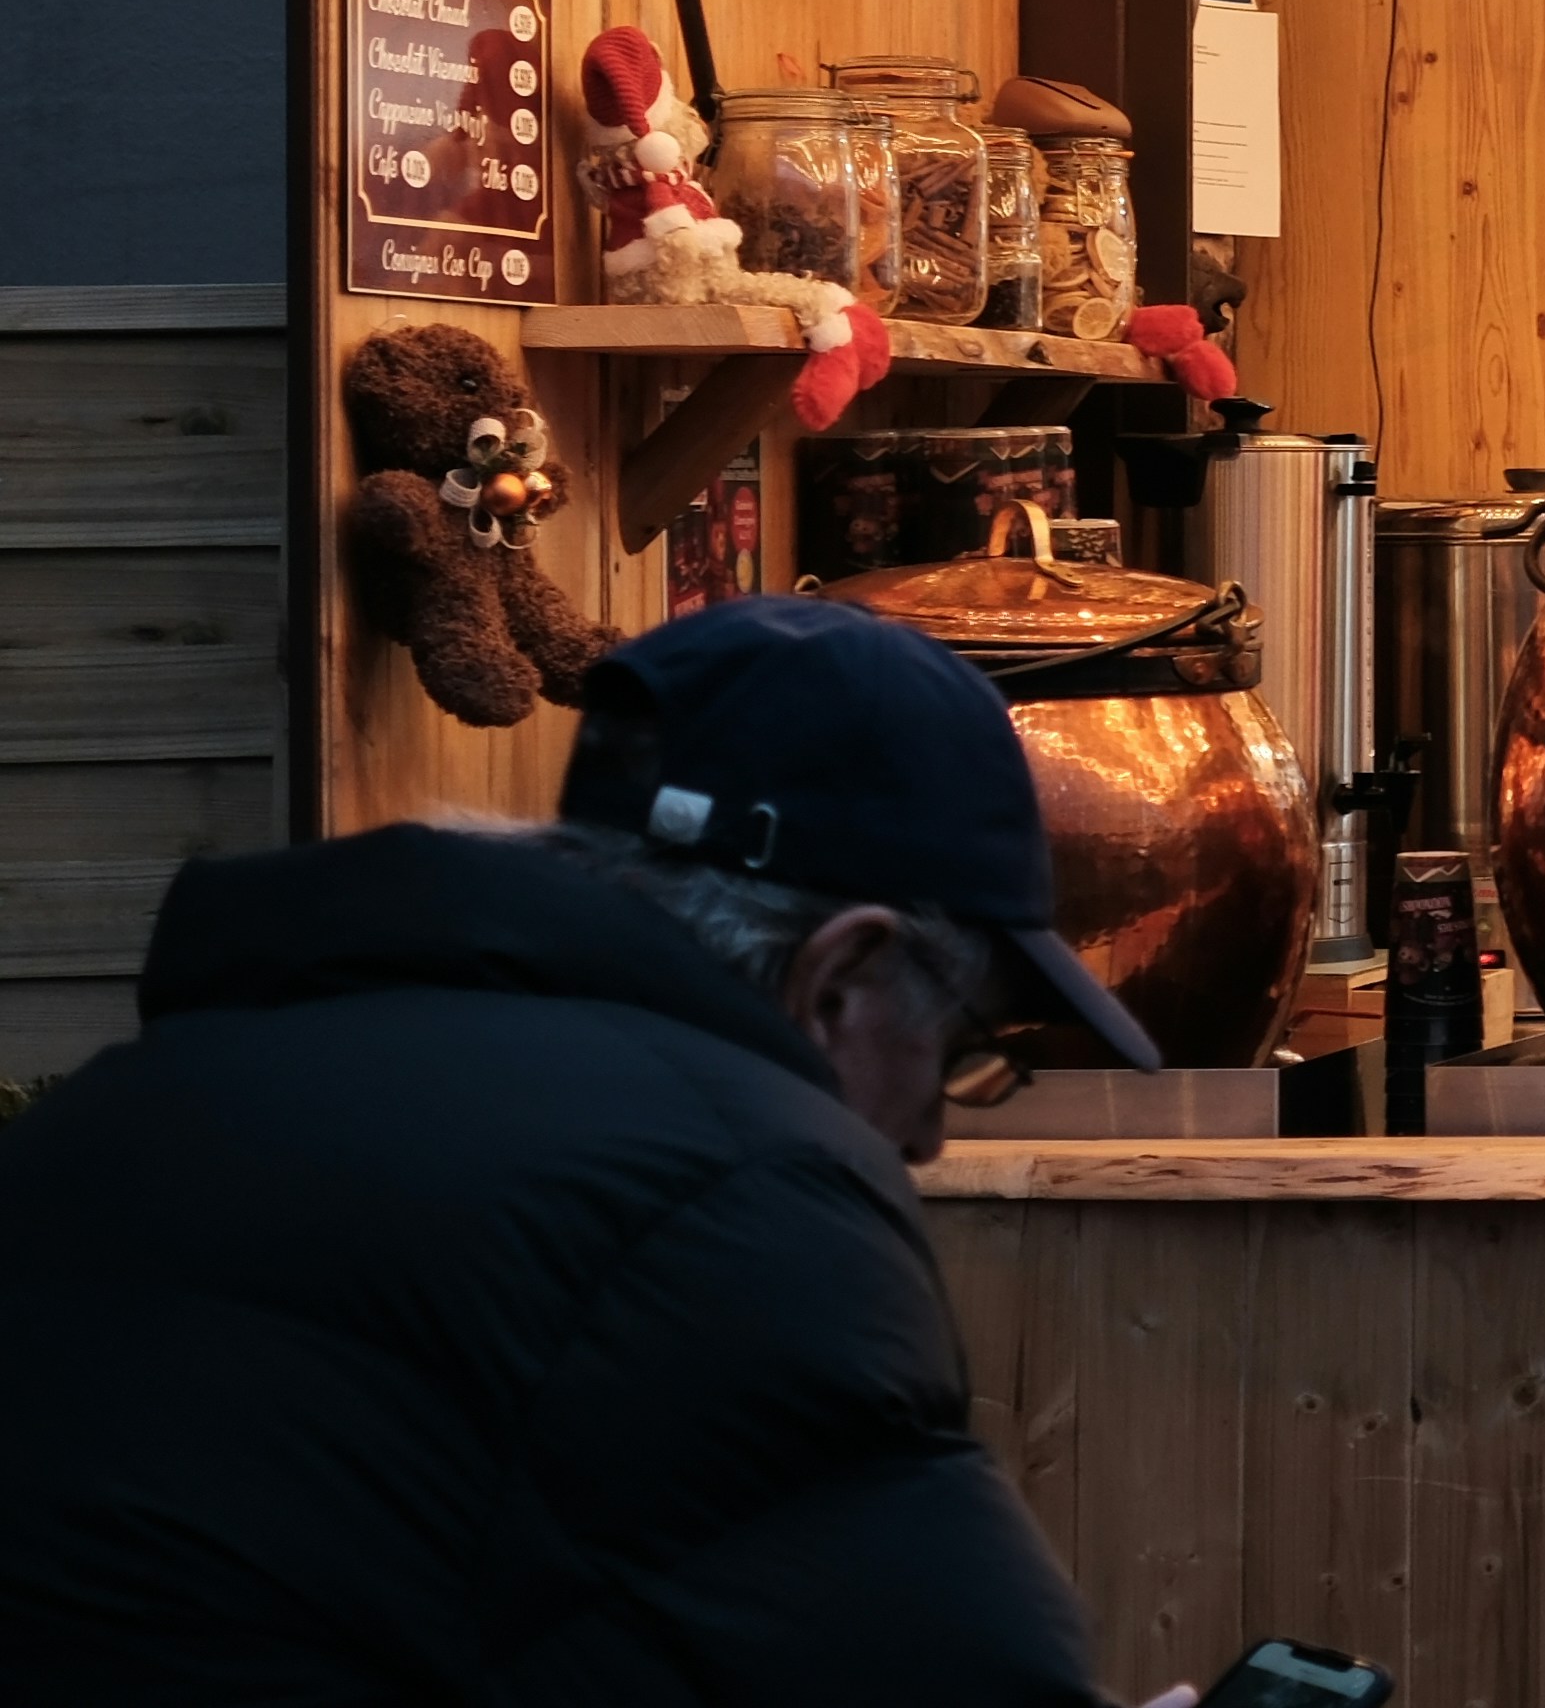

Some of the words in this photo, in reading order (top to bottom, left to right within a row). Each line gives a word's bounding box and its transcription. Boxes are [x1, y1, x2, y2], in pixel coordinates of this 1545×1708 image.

[368, 36, 428, 76] Chocolat
[428, 45, 479, 84] Viennois
[368, 144, 398, 184] Café
[481, 157, 508, 191] Thé
[442, 244, 466, 277] Eco
[468, 246, 493, 292] Cup
